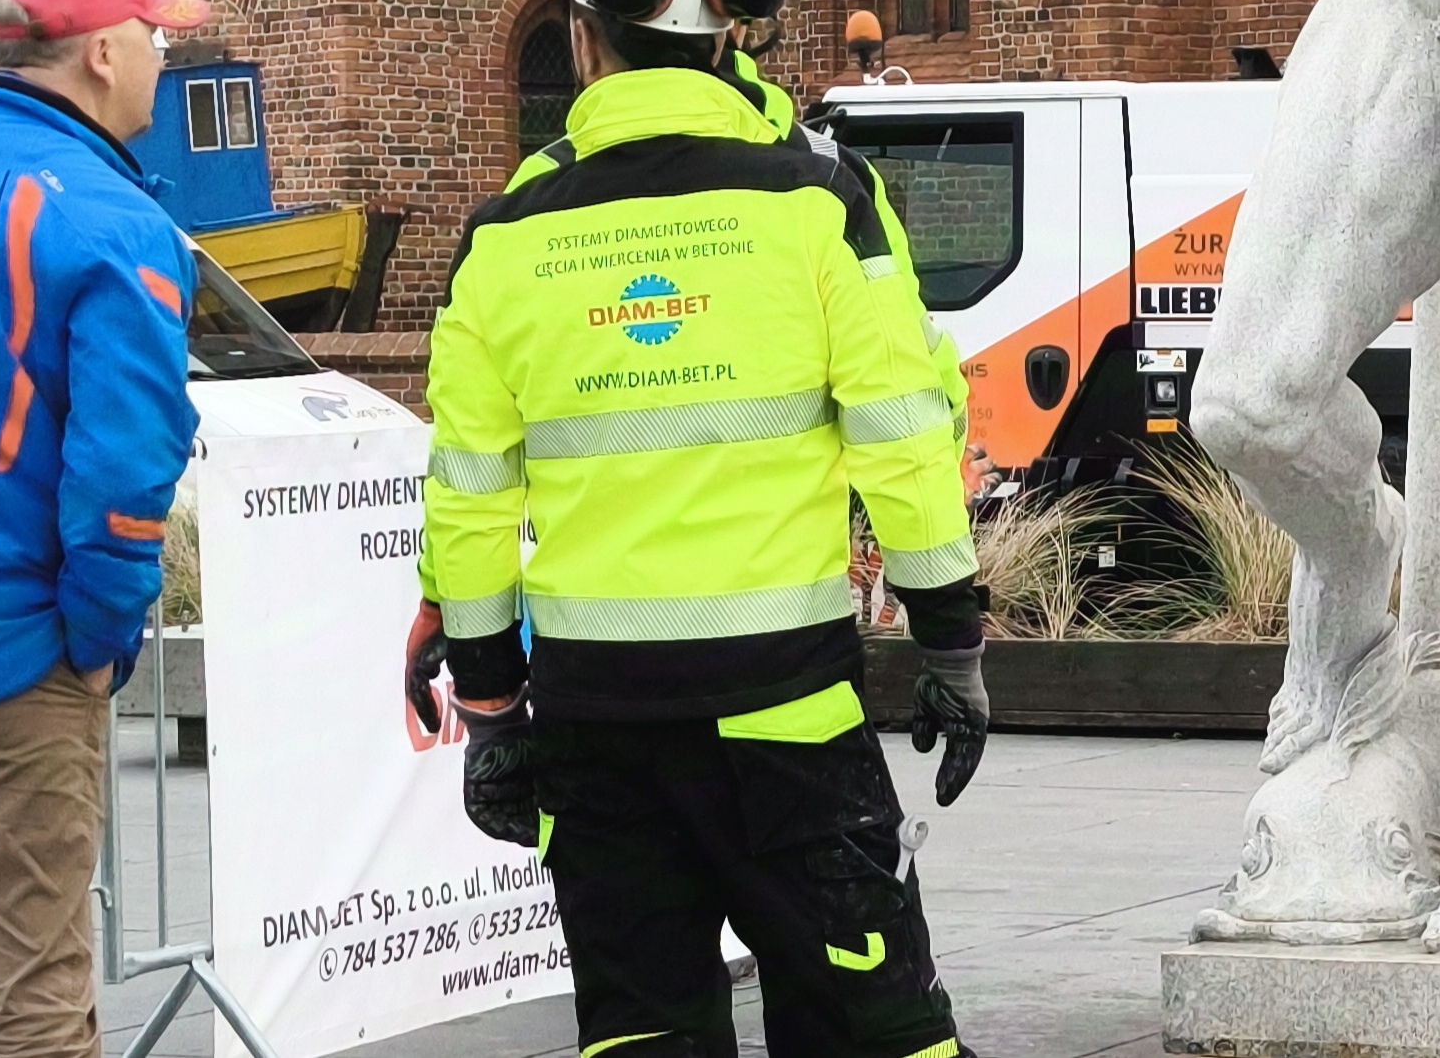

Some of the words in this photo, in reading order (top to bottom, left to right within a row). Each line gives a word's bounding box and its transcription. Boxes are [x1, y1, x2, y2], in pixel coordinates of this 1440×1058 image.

[548, 230, 610, 251] SYSTEMY
[615, 217, 739, 243] DIAMENTOWEGO
[590, 247, 671, 269] WIERCENIA
[674, 246, 689, 260] W
[692, 240, 755, 258] BETONIE
[588, 294, 711, 327] DIAM-BET
[1140, 287, 1222, 314] LIEB
[574, 363, 737, 393] WWW.DIAM-BET.PL
[243, 483, 331, 519] SYSTEMY
[371, 889, 401, 926] Sp.
[407, 890, 417, 912] z
[422, 882, 458, 909] o.o.
[464, 866, 487, 900] ul.
[341, 938, 377, 976] 784
[382, 929, 420, 965] 537
[423, 920, 461, 956] 286,
[486, 906, 523, 940] 533
[525, 901, 559, 932] 226
